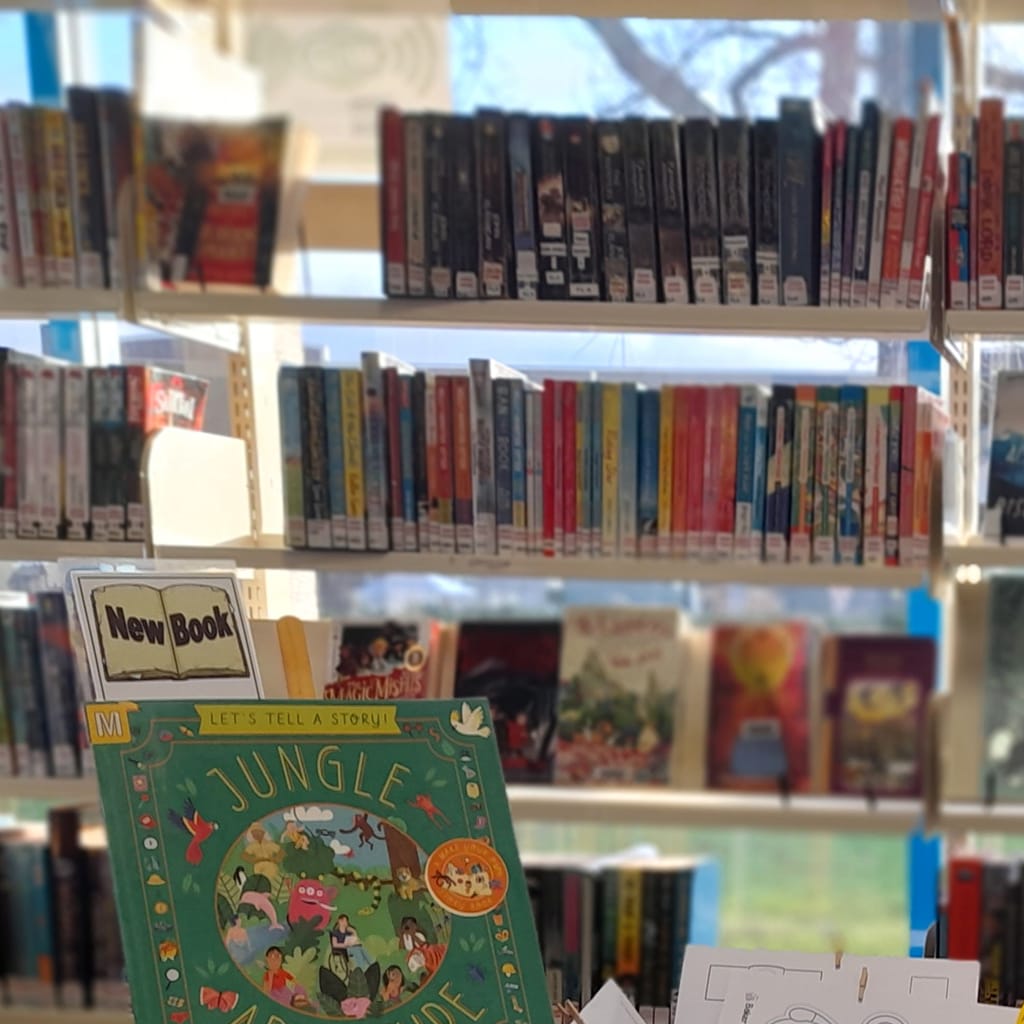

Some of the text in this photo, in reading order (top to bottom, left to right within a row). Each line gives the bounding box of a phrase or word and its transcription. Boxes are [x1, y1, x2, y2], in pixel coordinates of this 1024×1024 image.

[105, 605, 233, 646] New Book
[209, 710, 388, 729] LET'S TELL A STORY!
[206, 744, 411, 812] JUNGLE
